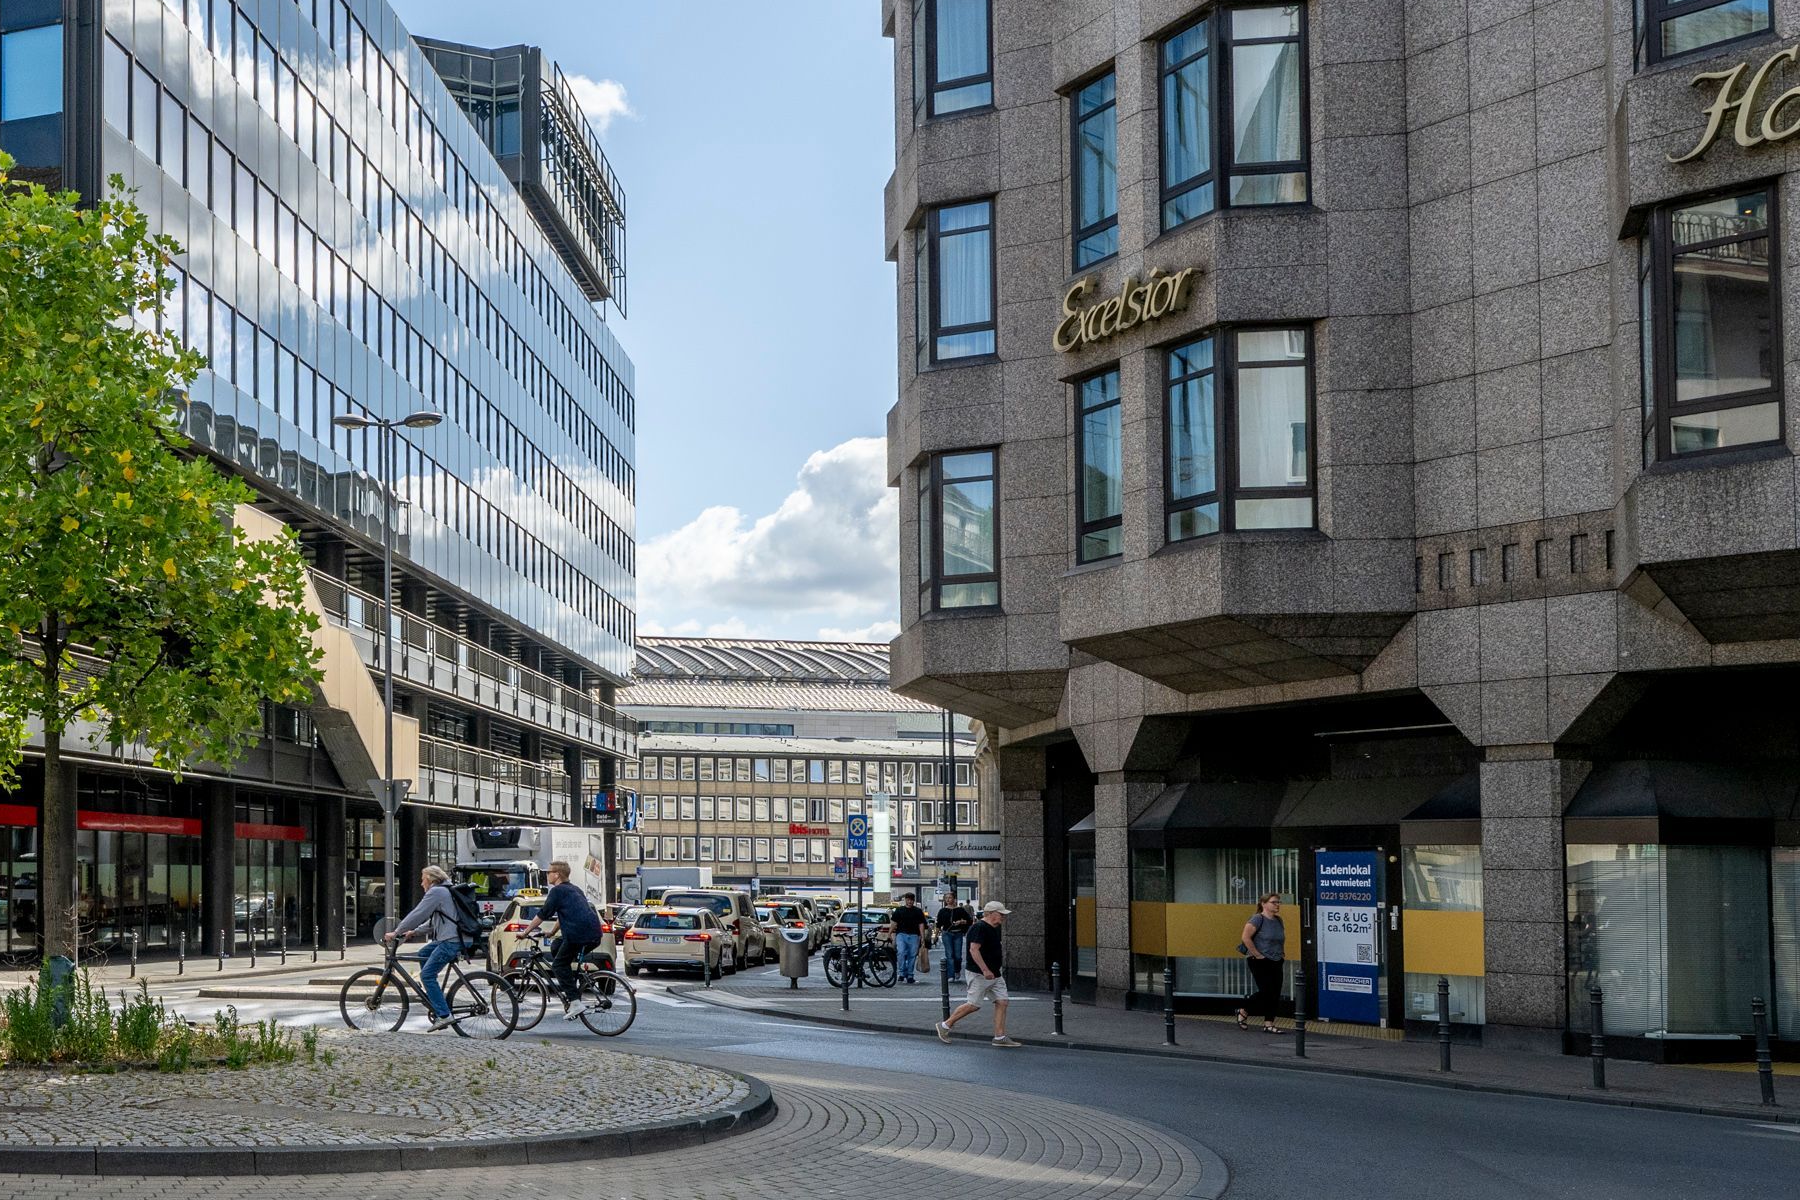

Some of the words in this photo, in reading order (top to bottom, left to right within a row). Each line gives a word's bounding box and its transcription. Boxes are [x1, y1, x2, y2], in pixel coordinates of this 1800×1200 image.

[1052, 265, 1203, 353] Excelsior
[789, 823, 809, 835] ibis
[849, 838, 866, 847] TAXI
[947, 841, 1001, 851] Restaurant
[1320, 864, 1371, 875] Ladenlokal
[1320, 879, 1330, 887] zu
[1331, 878, 1371, 887] vermieten!
[1320, 892, 1338, 900] 0221
[1339, 892, 1371, 901] 9376220
[1327, 911, 1341, 922] EG
[1343, 912, 1350, 922] &
[1352, 912, 1368, 923] UG
[1330, 976, 1370, 985] ASSENMACHER
